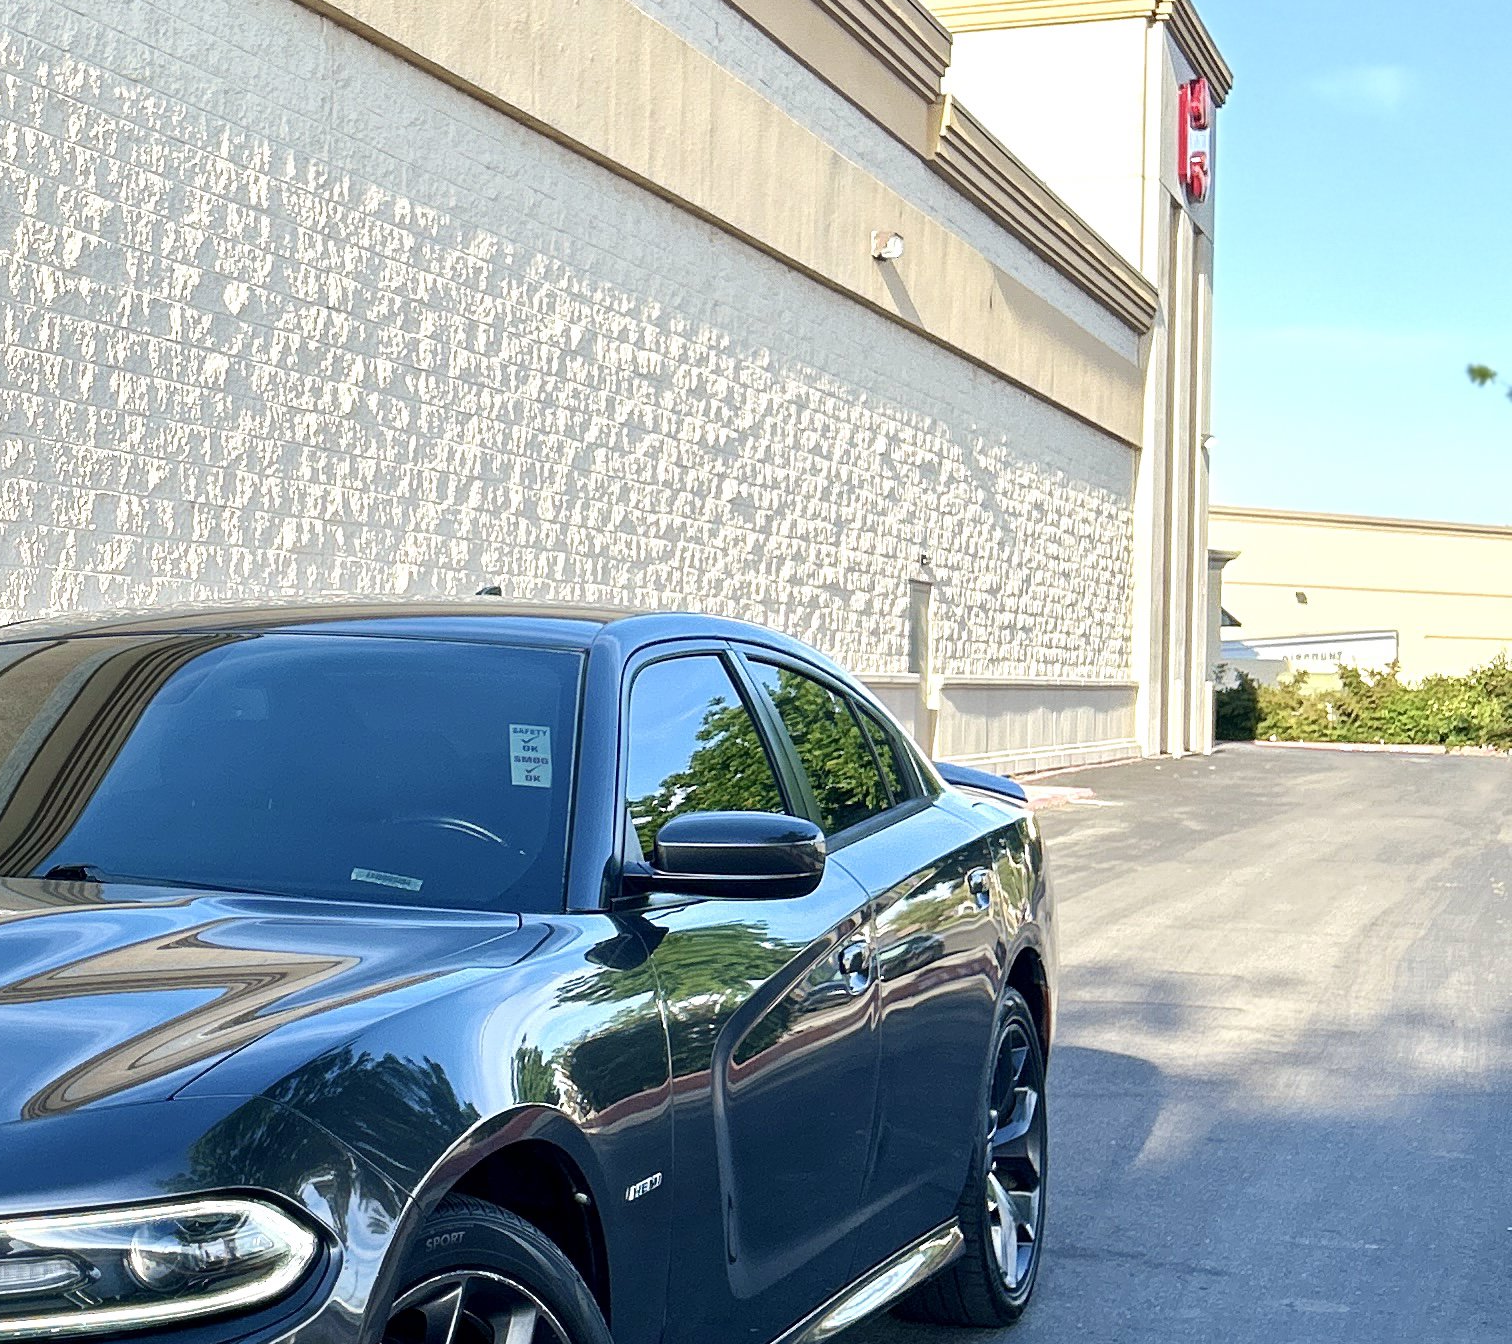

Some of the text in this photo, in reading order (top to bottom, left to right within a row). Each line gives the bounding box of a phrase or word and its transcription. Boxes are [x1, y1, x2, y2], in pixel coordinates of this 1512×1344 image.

[512, 727, 547, 736] SAFETY
[514, 755, 549, 764] SMOG
[525, 774, 541, 782] OK
[426, 1231, 465, 1252] SPORT
